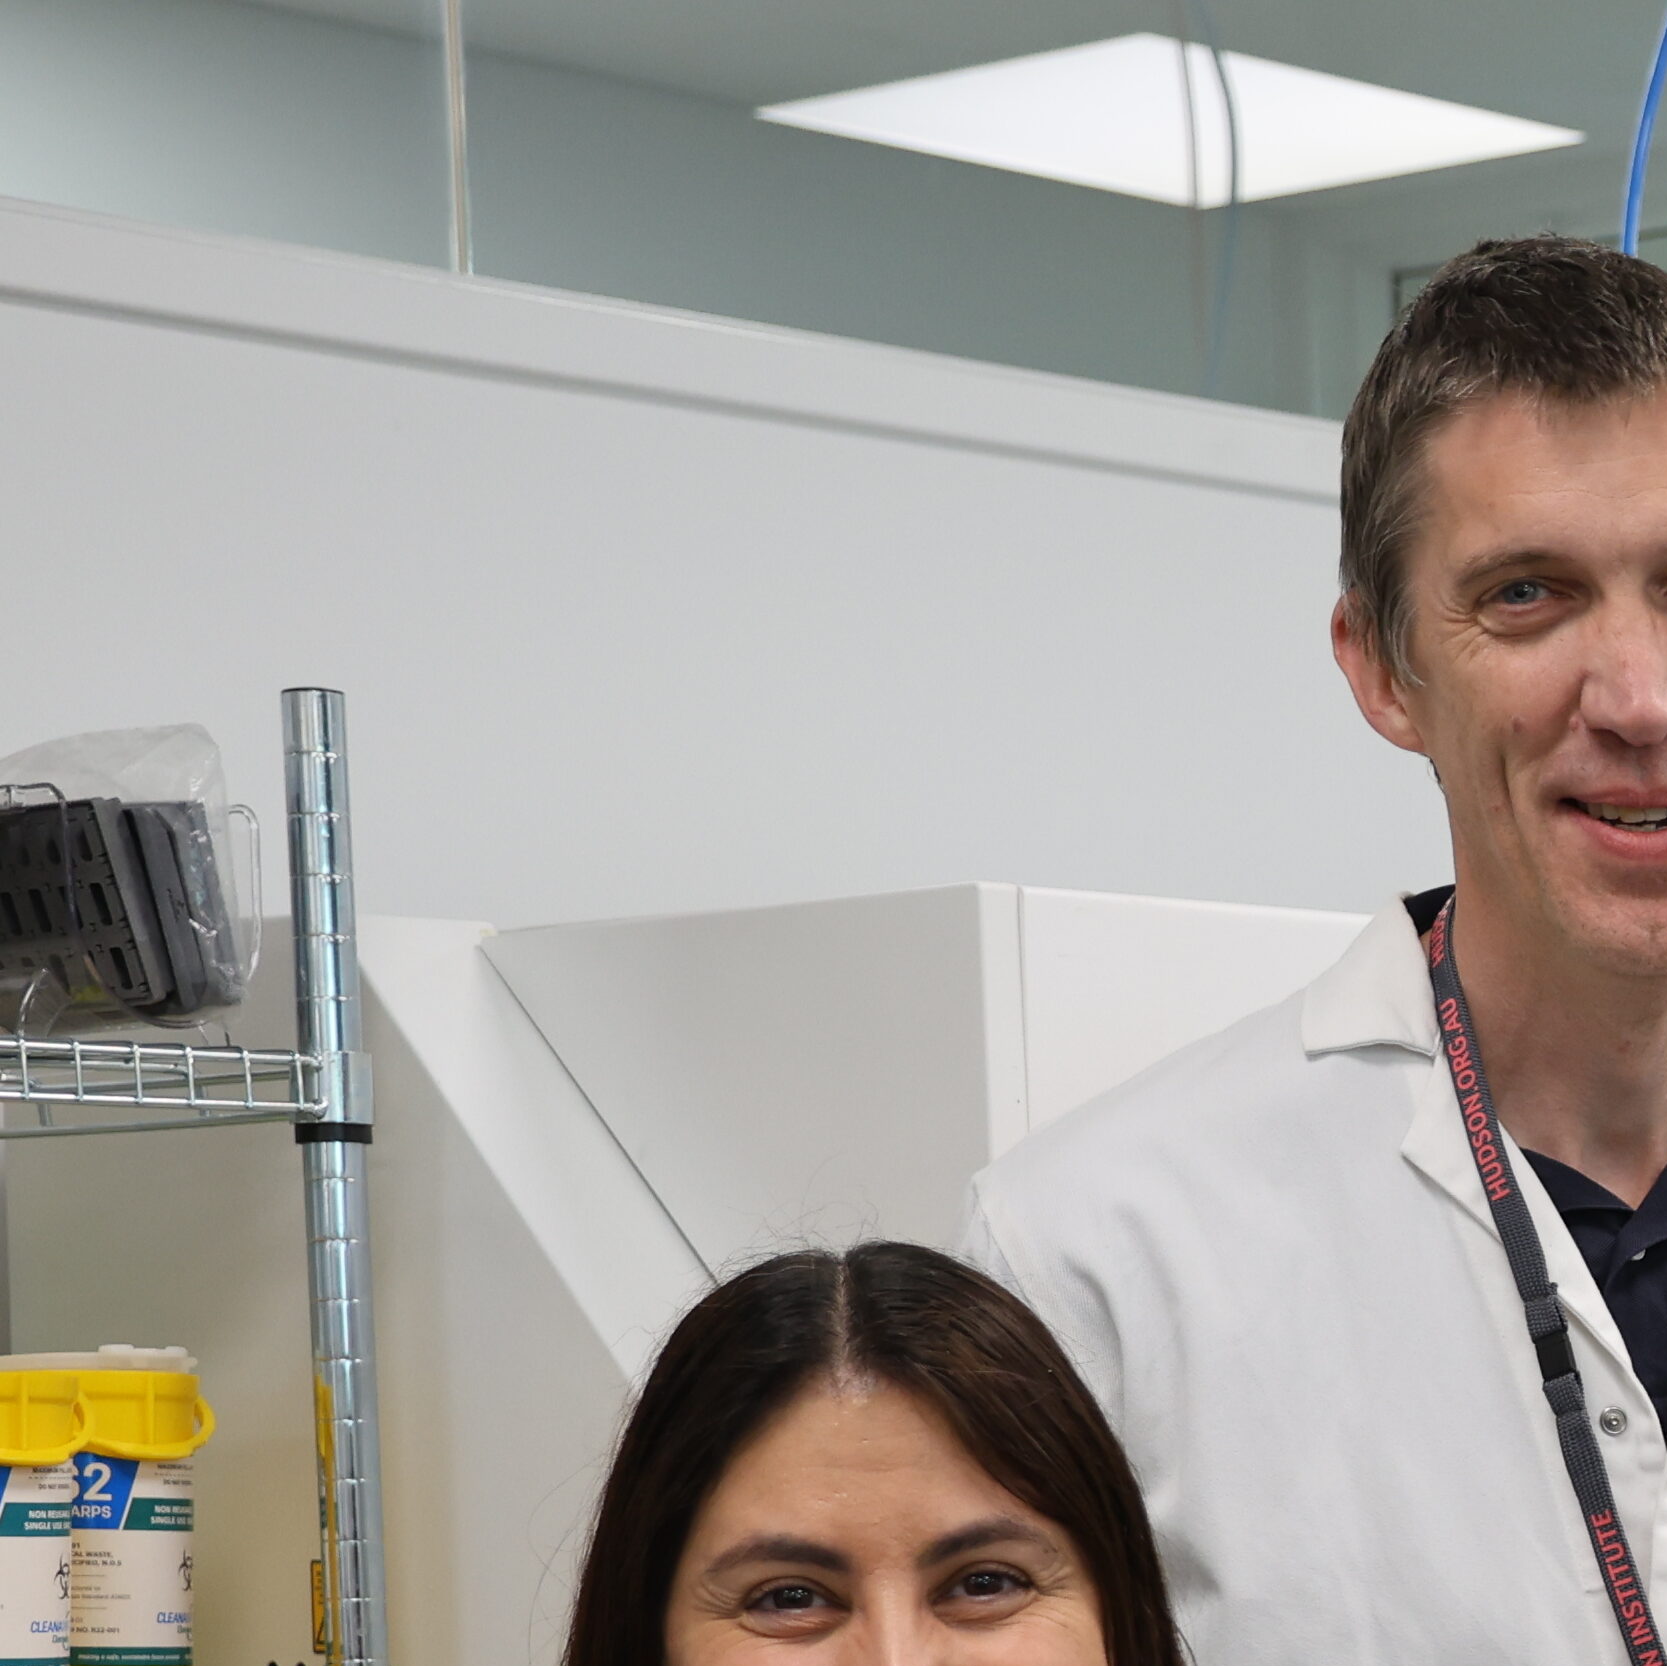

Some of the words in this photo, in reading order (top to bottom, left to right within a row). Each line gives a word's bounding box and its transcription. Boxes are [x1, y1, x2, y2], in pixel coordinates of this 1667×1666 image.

[1440, 998, 1511, 1201] HUDSON.ORG.AU
[72, 1505, 112, 1518] ARPS
[1591, 1509, 1654, 1646] INSTITUTE
